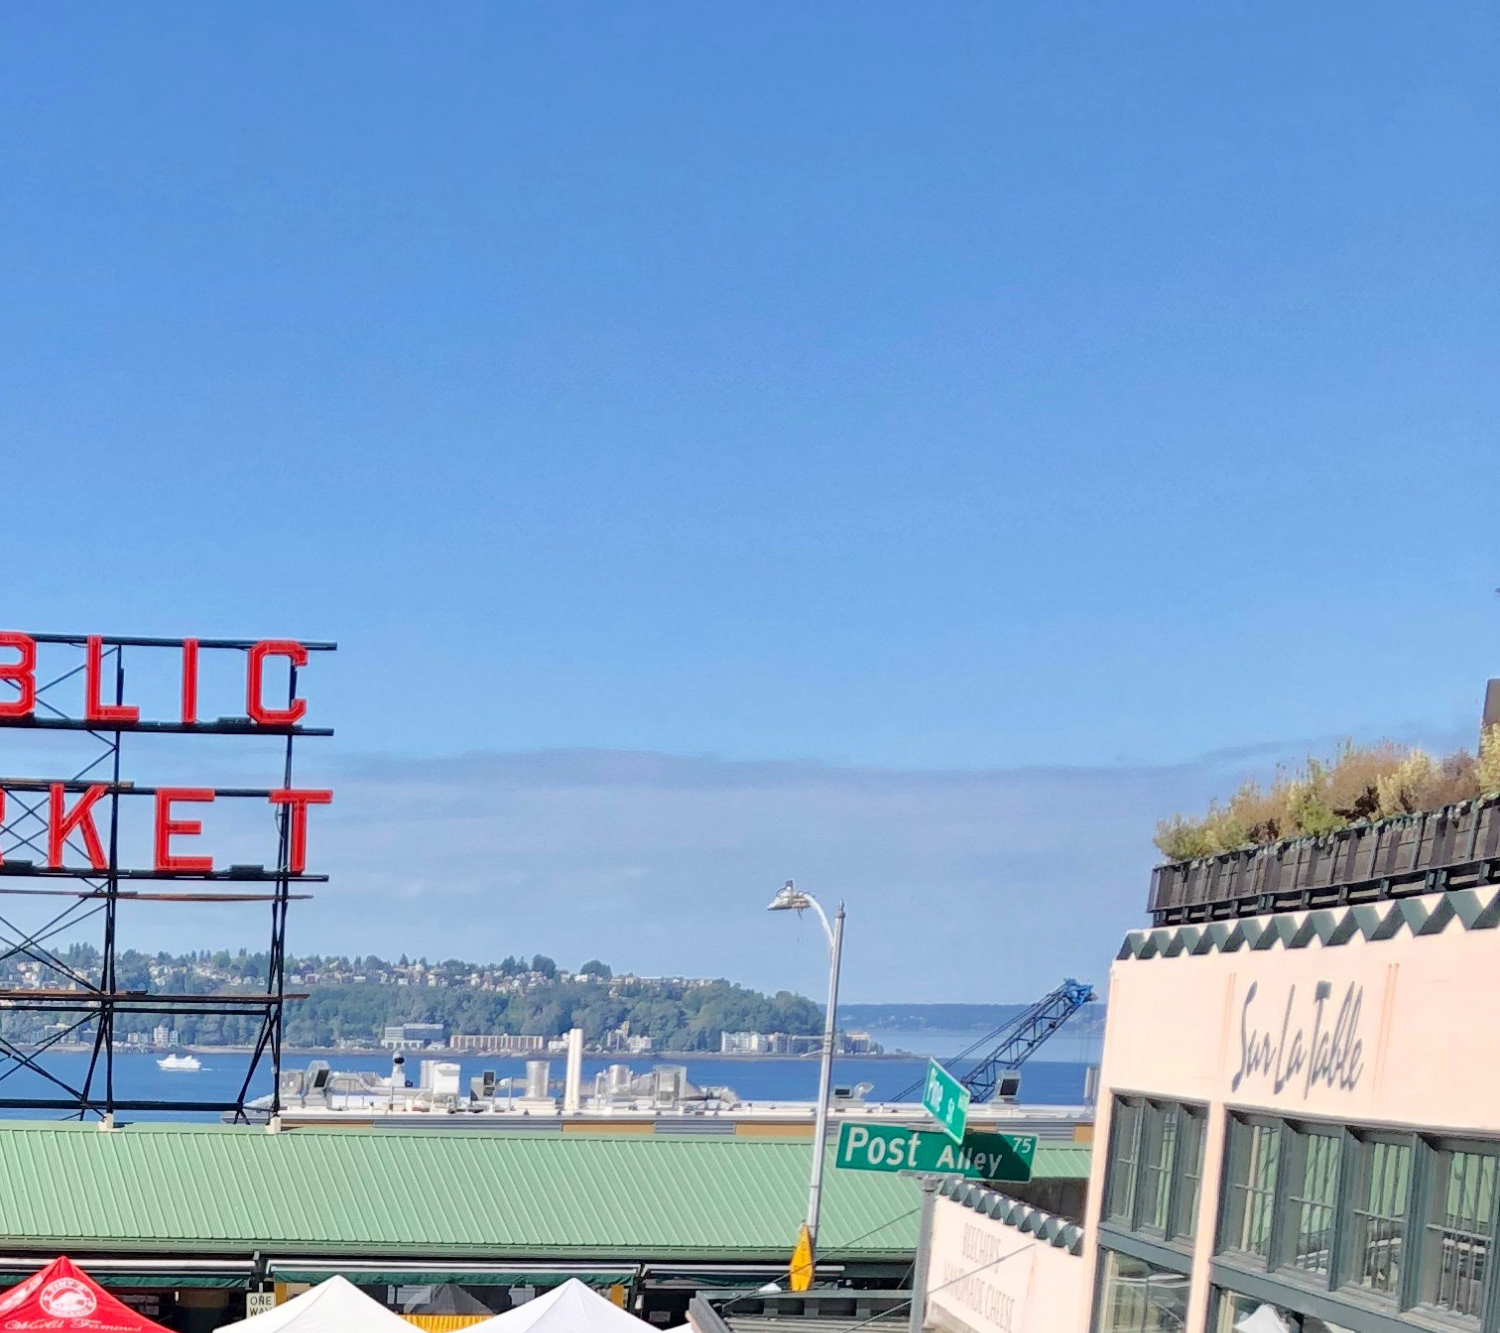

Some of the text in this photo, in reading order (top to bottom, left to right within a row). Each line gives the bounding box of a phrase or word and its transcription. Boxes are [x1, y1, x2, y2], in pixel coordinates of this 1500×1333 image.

[1231, 980, 1364, 1101] Sur La Table
[844, 1126, 1003, 1178] Post Alley
[1012, 1136, 1032, 1154] 75
[250, 1295, 272, 1305] ONE
